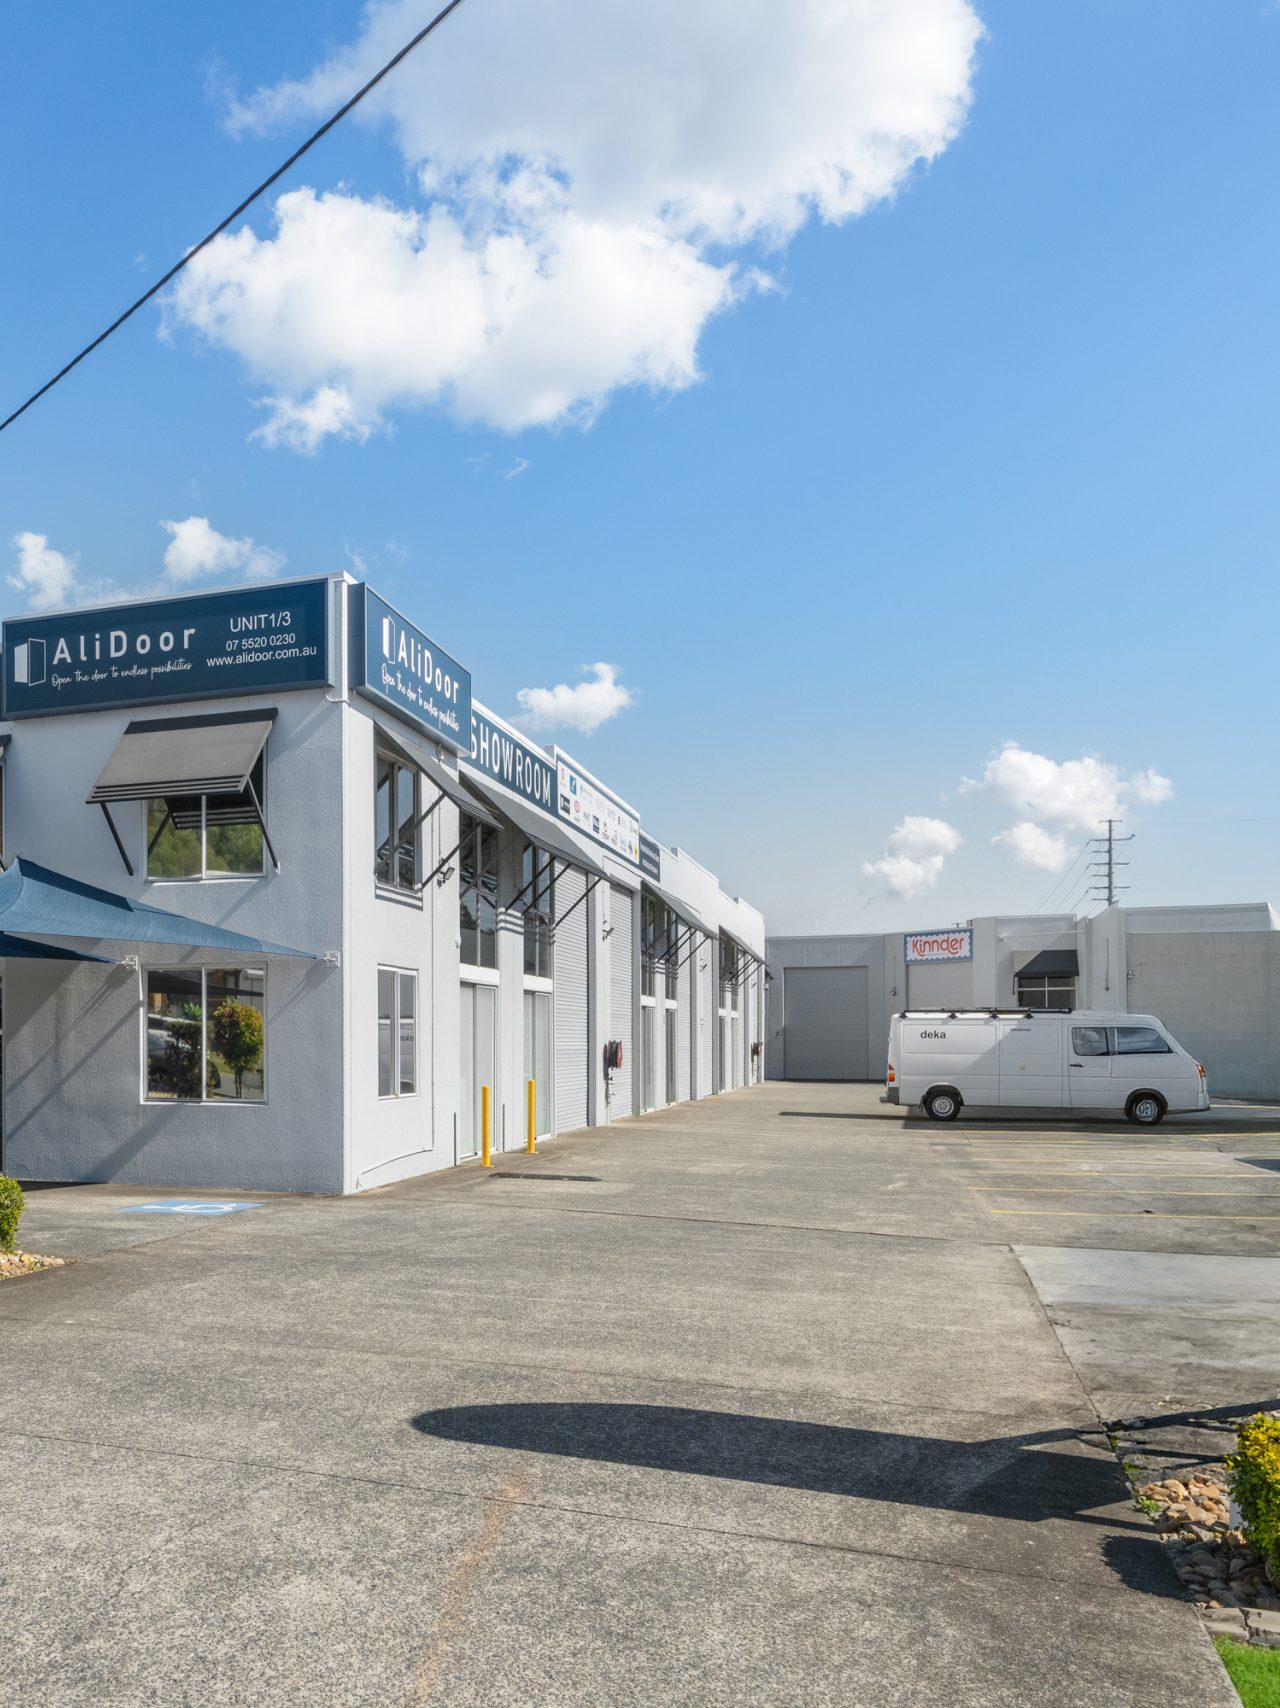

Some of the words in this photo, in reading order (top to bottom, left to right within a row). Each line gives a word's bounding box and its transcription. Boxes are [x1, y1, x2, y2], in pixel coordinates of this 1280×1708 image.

[230, 611, 292, 632] UNIT1/3
[52, 628, 196, 665] AliDoor
[225, 640, 239, 651] 07
[241, 637, 267, 649] 5520
[269, 633, 296, 646] 0230
[206, 646, 317, 667] www.alidoor.com.au
[398, 630, 459, 704] AliDoor
[51, 673, 72, 691] Open
[74, 669, 90, 682] the
[91, 669, 109, 682] door
[110, 665, 119, 678] to
[121, 664, 149, 677] endless
[150, 657, 193, 680] possibilities
[912, 937, 965, 957] Kinnder
[920, 1030, 946, 1039] deka
